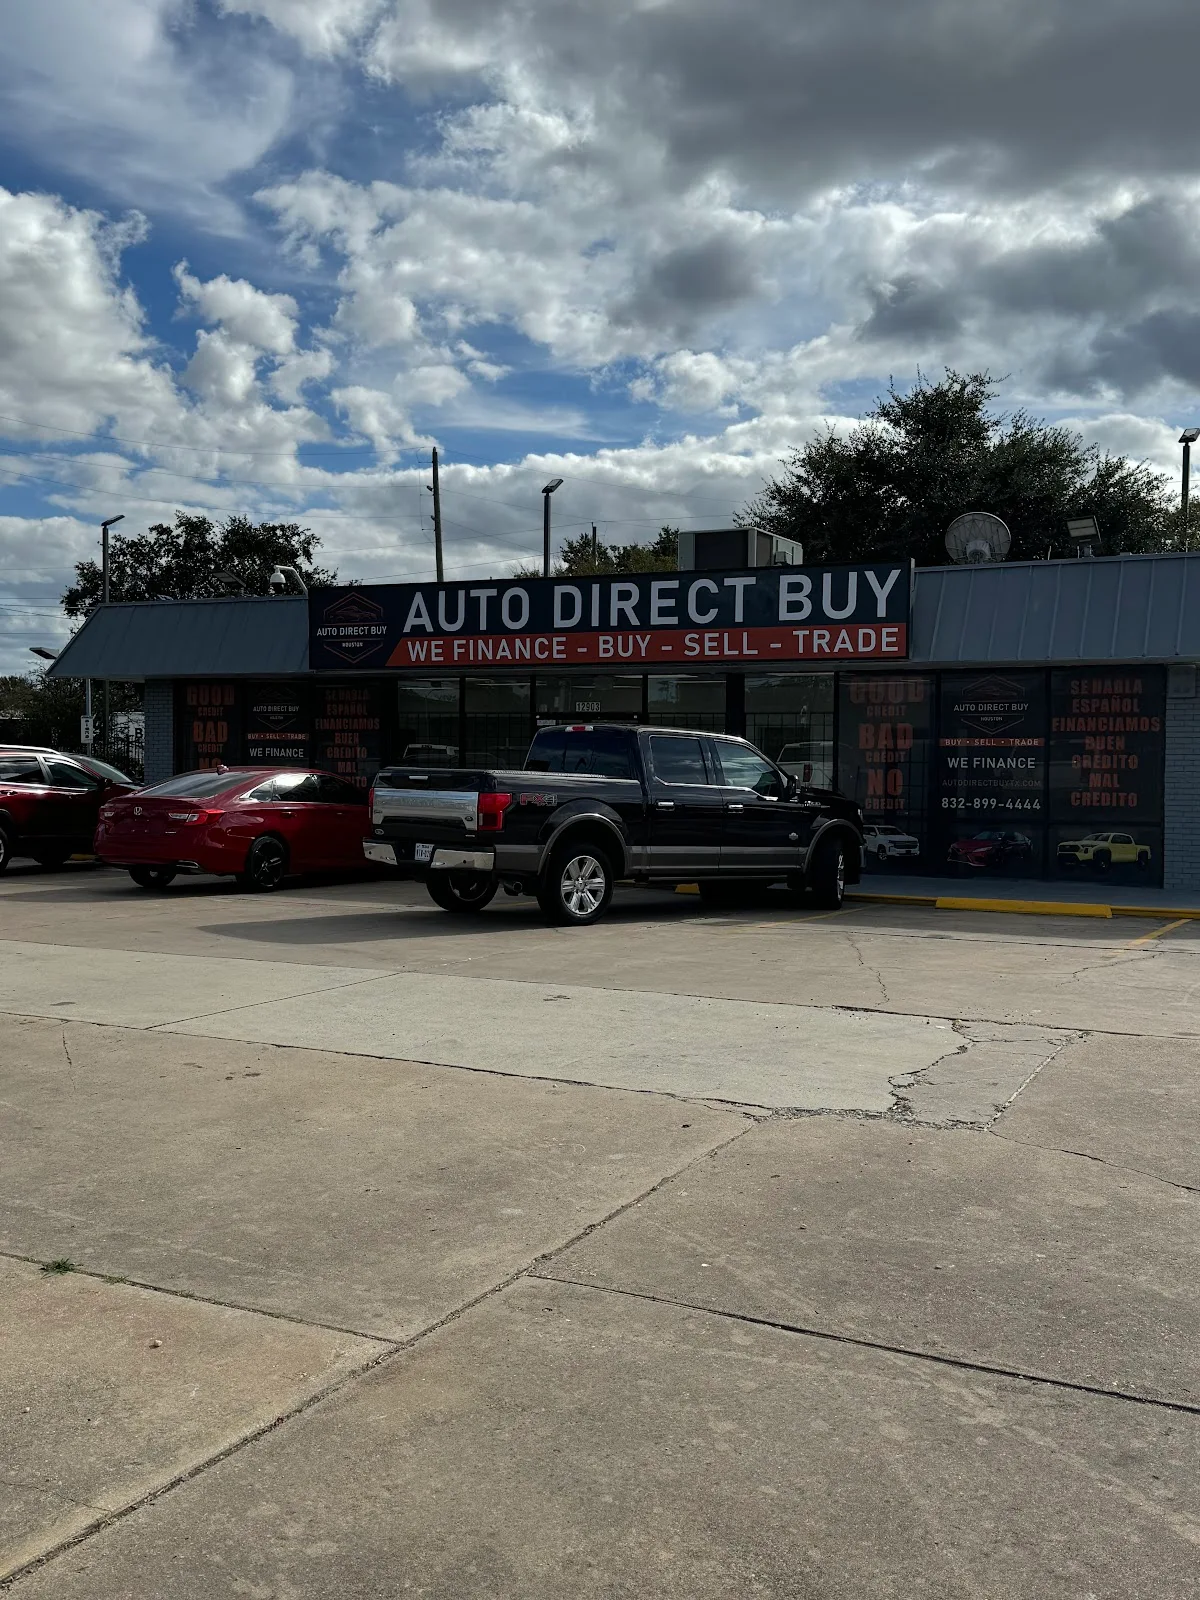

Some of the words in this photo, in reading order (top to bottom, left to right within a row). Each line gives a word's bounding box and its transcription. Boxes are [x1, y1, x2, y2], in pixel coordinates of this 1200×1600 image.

[404, 586, 531, 634] AUTO
[552, 576, 760, 629] DIRECT
[777, 568, 903, 623] BUY
[316, 627, 338, 637] AUTO
[339, 626, 370, 636] DIRECT
[370, 625, 388, 635] BUY
[406, 639, 445, 663] WE
[452, 636, 568, 662] FINANCE
[597, 634, 652, 658] BUY
[683, 632, 760, 657] SELL
[791, 628, 900, 655] TRADE
[1070, 680, 1089, 695] SE
[1092, 679, 1143, 695] HABLA
[576, 702, 600, 712] 12903
[866, 705, 907, 716] CREDIT
[953, 703, 976, 712] AUTO
[977, 703, 1010, 712] DIRECT
[1011, 703, 1029, 711] BUY
[1072, 695, 1140, 713] ESPAÑOL
[197, 706, 224, 717] CREDIT
[314, 717, 380, 730] FINANCIAMOS
[1051, 716, 1161, 732] FINANCIAMOS
[193, 720, 229, 743] BAD
[858, 722, 914, 750] BAD
[334, 732, 360, 745] BUEN
[945, 738, 962, 746] BUY
[974, 738, 997, 746] SELL
[1009, 738, 1039, 746] TRADE
[1085, 736, 1126, 751] BUEN
[197, 743, 224, 754] CREDIT
[249, 747, 263, 757] WE
[265, 747, 305, 758] FINANCE
[865, 751, 907, 763] CREDIT
[947, 757, 969, 769] WE
[973, 757, 1036, 769] FINANCE
[337, 761, 357, 773] MAL
[867, 768, 904, 796] NO
[942, 779, 1041, 787] AUTODIRECTBUYTX.COM
[1089, 773, 1120, 788] MAL
[519, 792, 558, 807] FX4
[865, 798, 905, 811] CREDIT
[941, 797, 1041, 810] 832-899-4444
[1070, 791, 1138, 807] CREDITO
